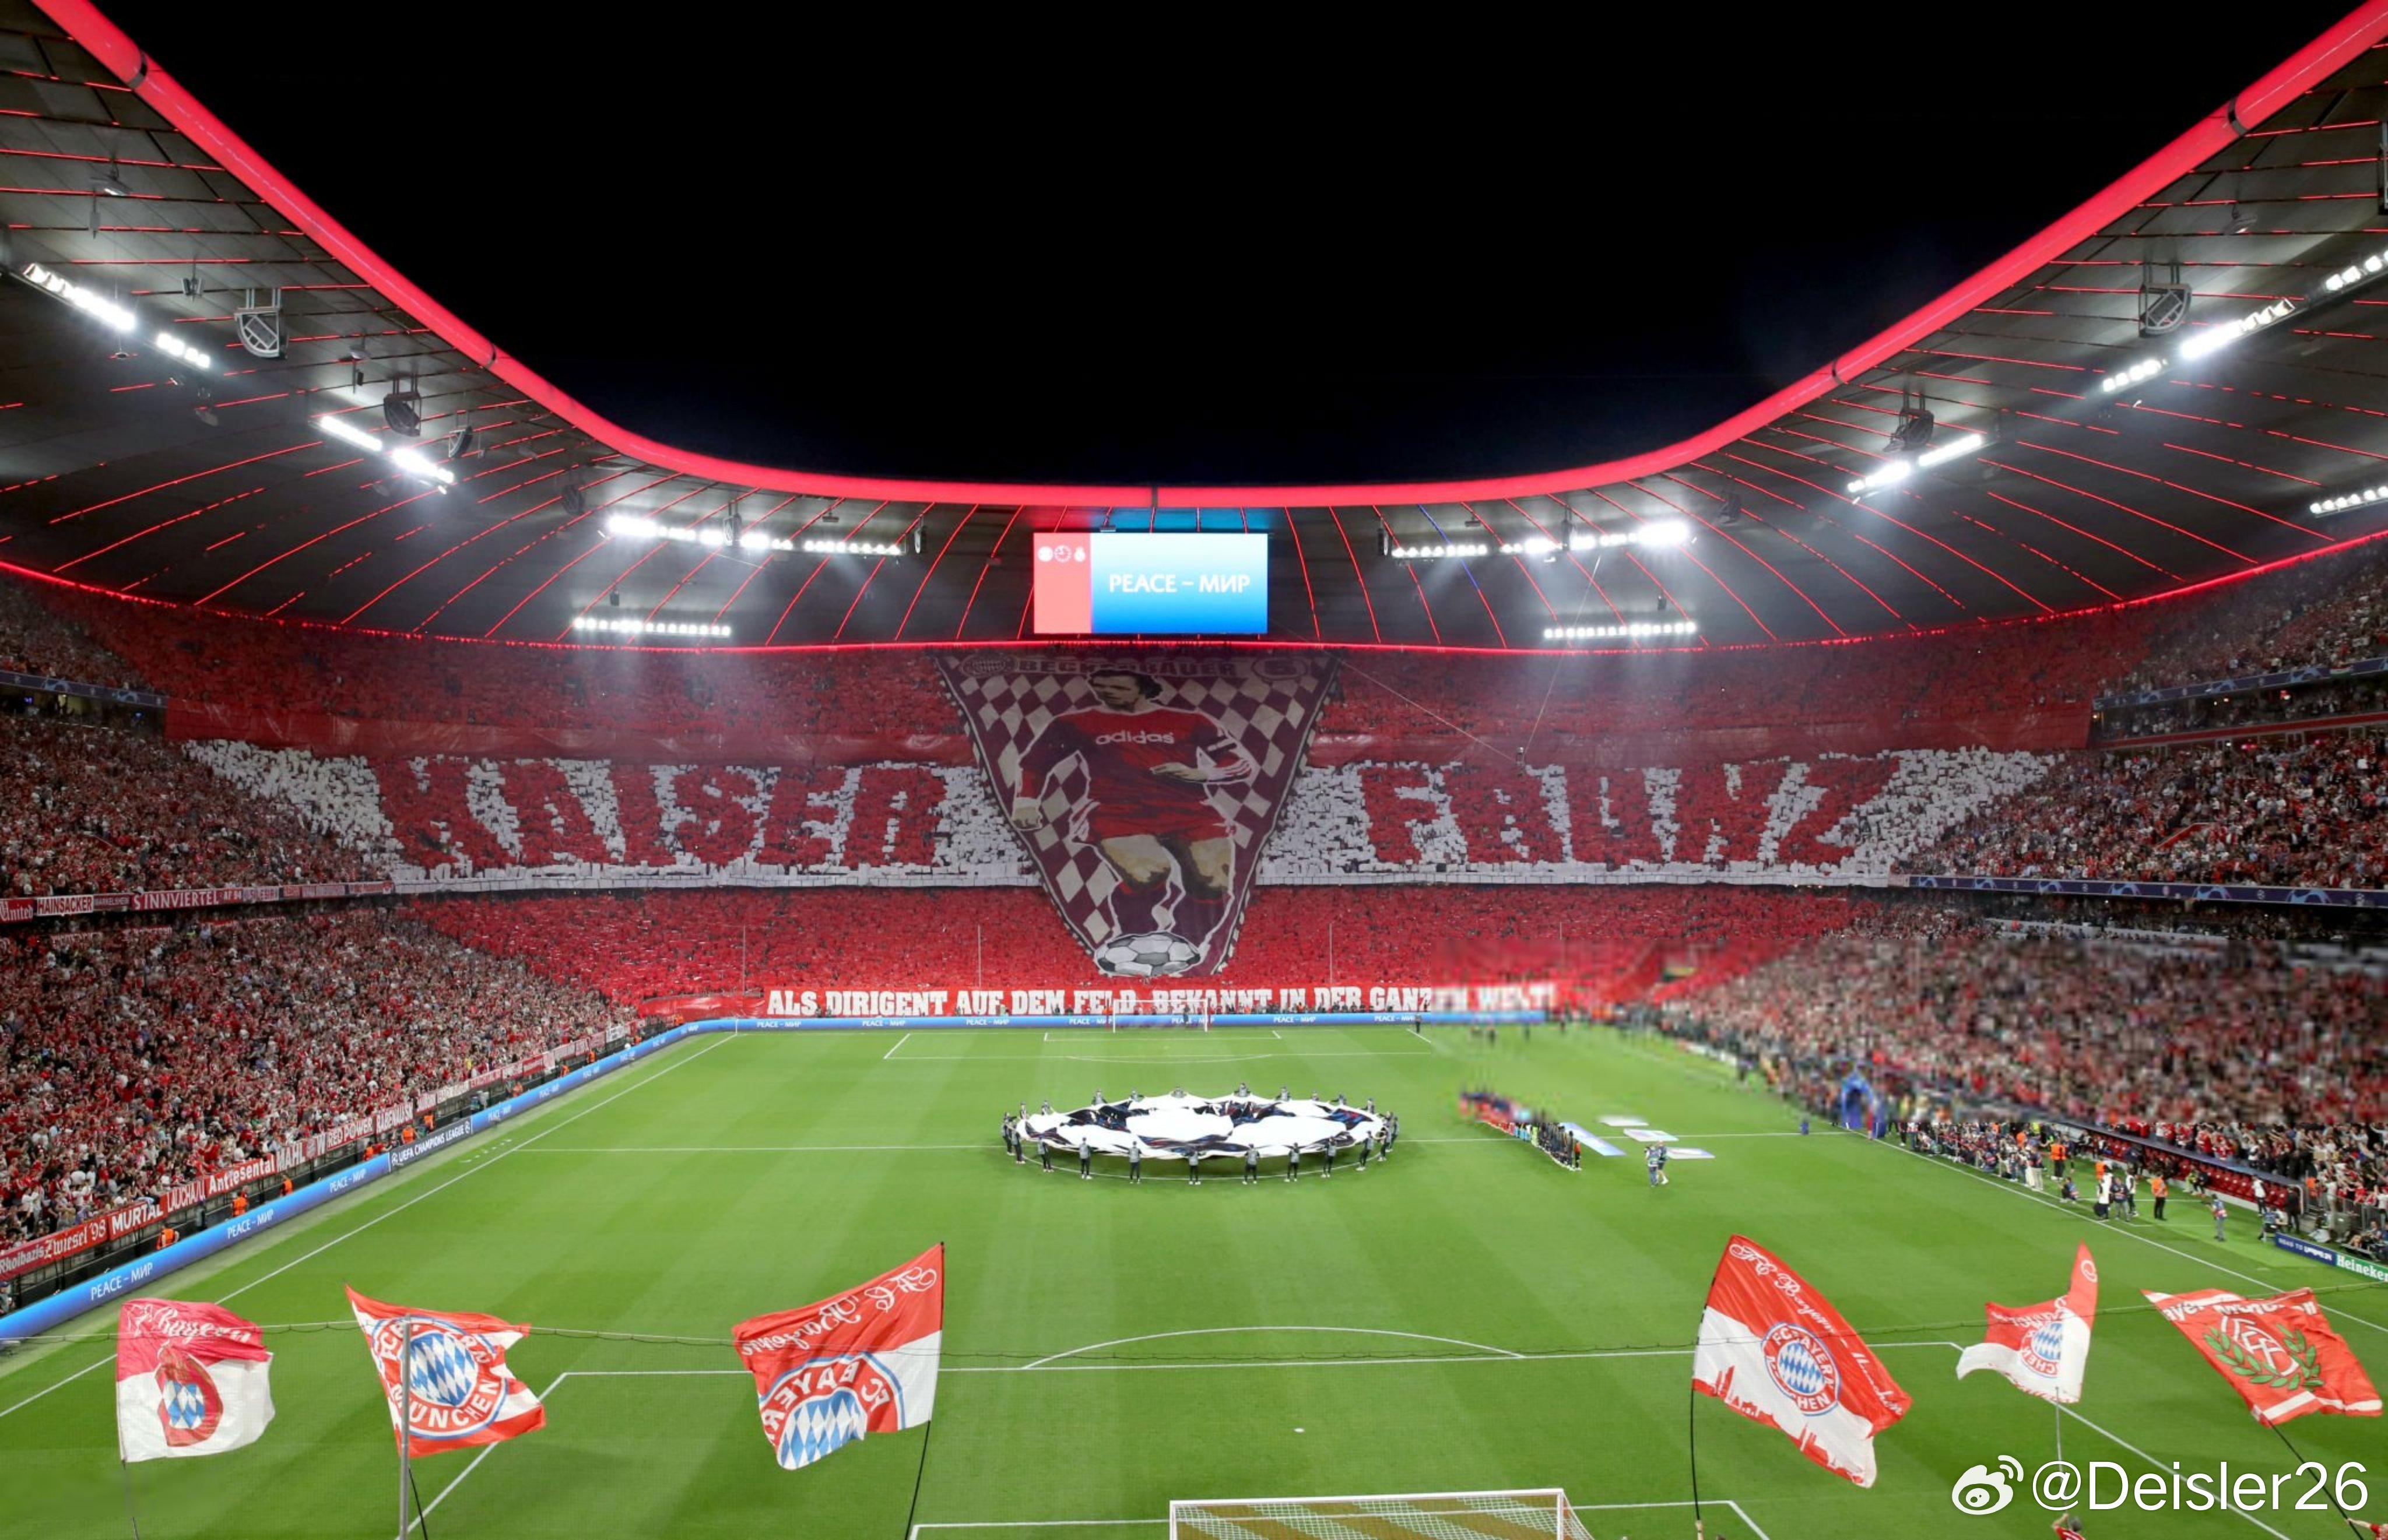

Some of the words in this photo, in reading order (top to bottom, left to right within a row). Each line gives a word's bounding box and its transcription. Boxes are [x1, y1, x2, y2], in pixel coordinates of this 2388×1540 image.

[1109, 573, 1177, 593] PEACE
[1199, 574, 1251, 593] МИР
[1095, 729, 1176, 746] adidas
[38, 896, 93, 915] HAINSACKER
[145, 891, 219, 909] INNVIERTEL
[767, 990, 817, 1016] ALS
[825, 990, 948, 1017] DIRIGENT
[955, 990, 1005, 1015] AUF
[1011, 989, 1065, 1015] DEM
[1280, 988, 1306, 1013] IN
[1314, 986, 1362, 1012] DER
[327, 1128, 343, 1147] RED
[343, 1117, 374, 1143] POWER
[398, 1148, 415, 1162] UEFA
[415, 1133, 445, 1155] CHAMPIONS
[445, 1124, 465, 1141] LEAGUE
[276, 1142, 307, 1173] MAHL
[329, 1179, 348, 1193] PEACE
[111, 1203, 164, 1235] MURTAL
[227, 1221, 251, 1239] PEACE
[91, 1275, 121, 1300] PEACE
[1772, 1327, 1792, 1346] FC
